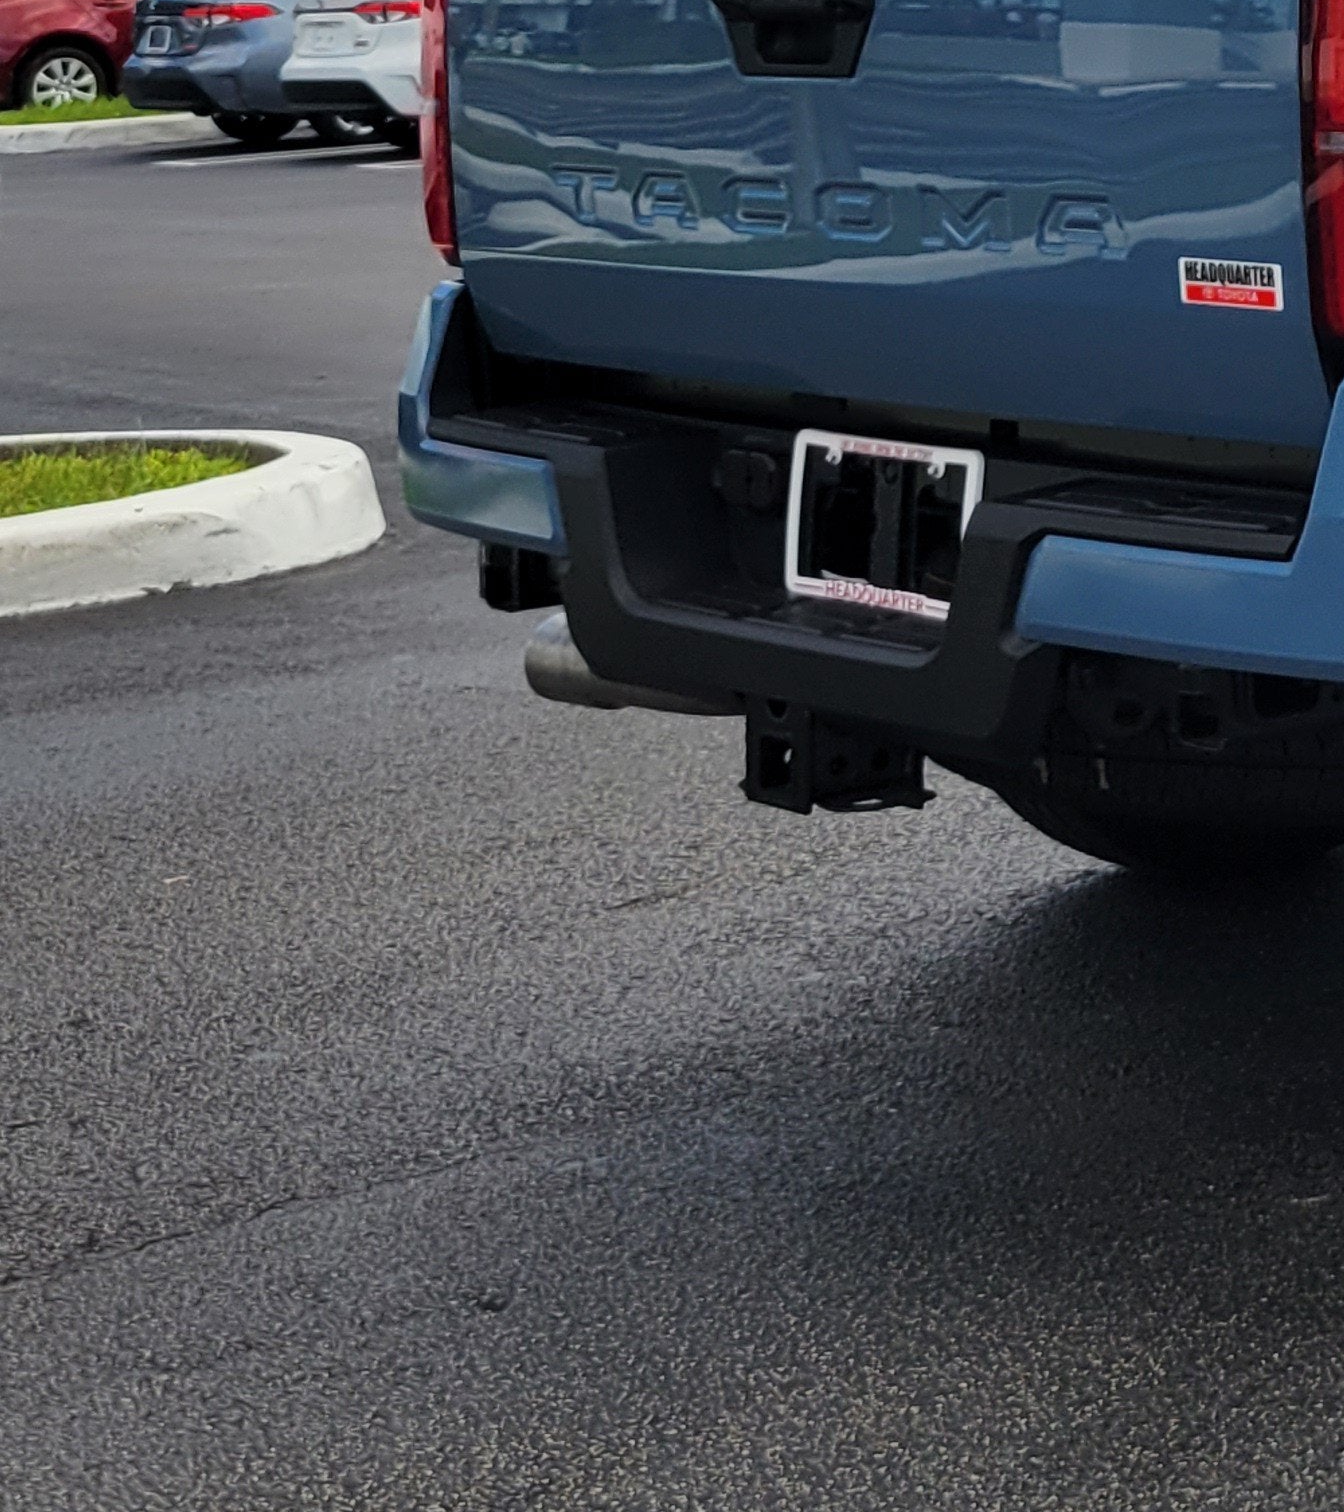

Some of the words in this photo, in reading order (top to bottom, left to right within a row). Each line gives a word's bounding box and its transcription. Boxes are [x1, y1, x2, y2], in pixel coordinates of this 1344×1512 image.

[551, 163, 1131, 261] TACOMA
[1184, 261, 1276, 287] HEADQUARTER
[826, 579, 925, 611] HEADQUARTER
